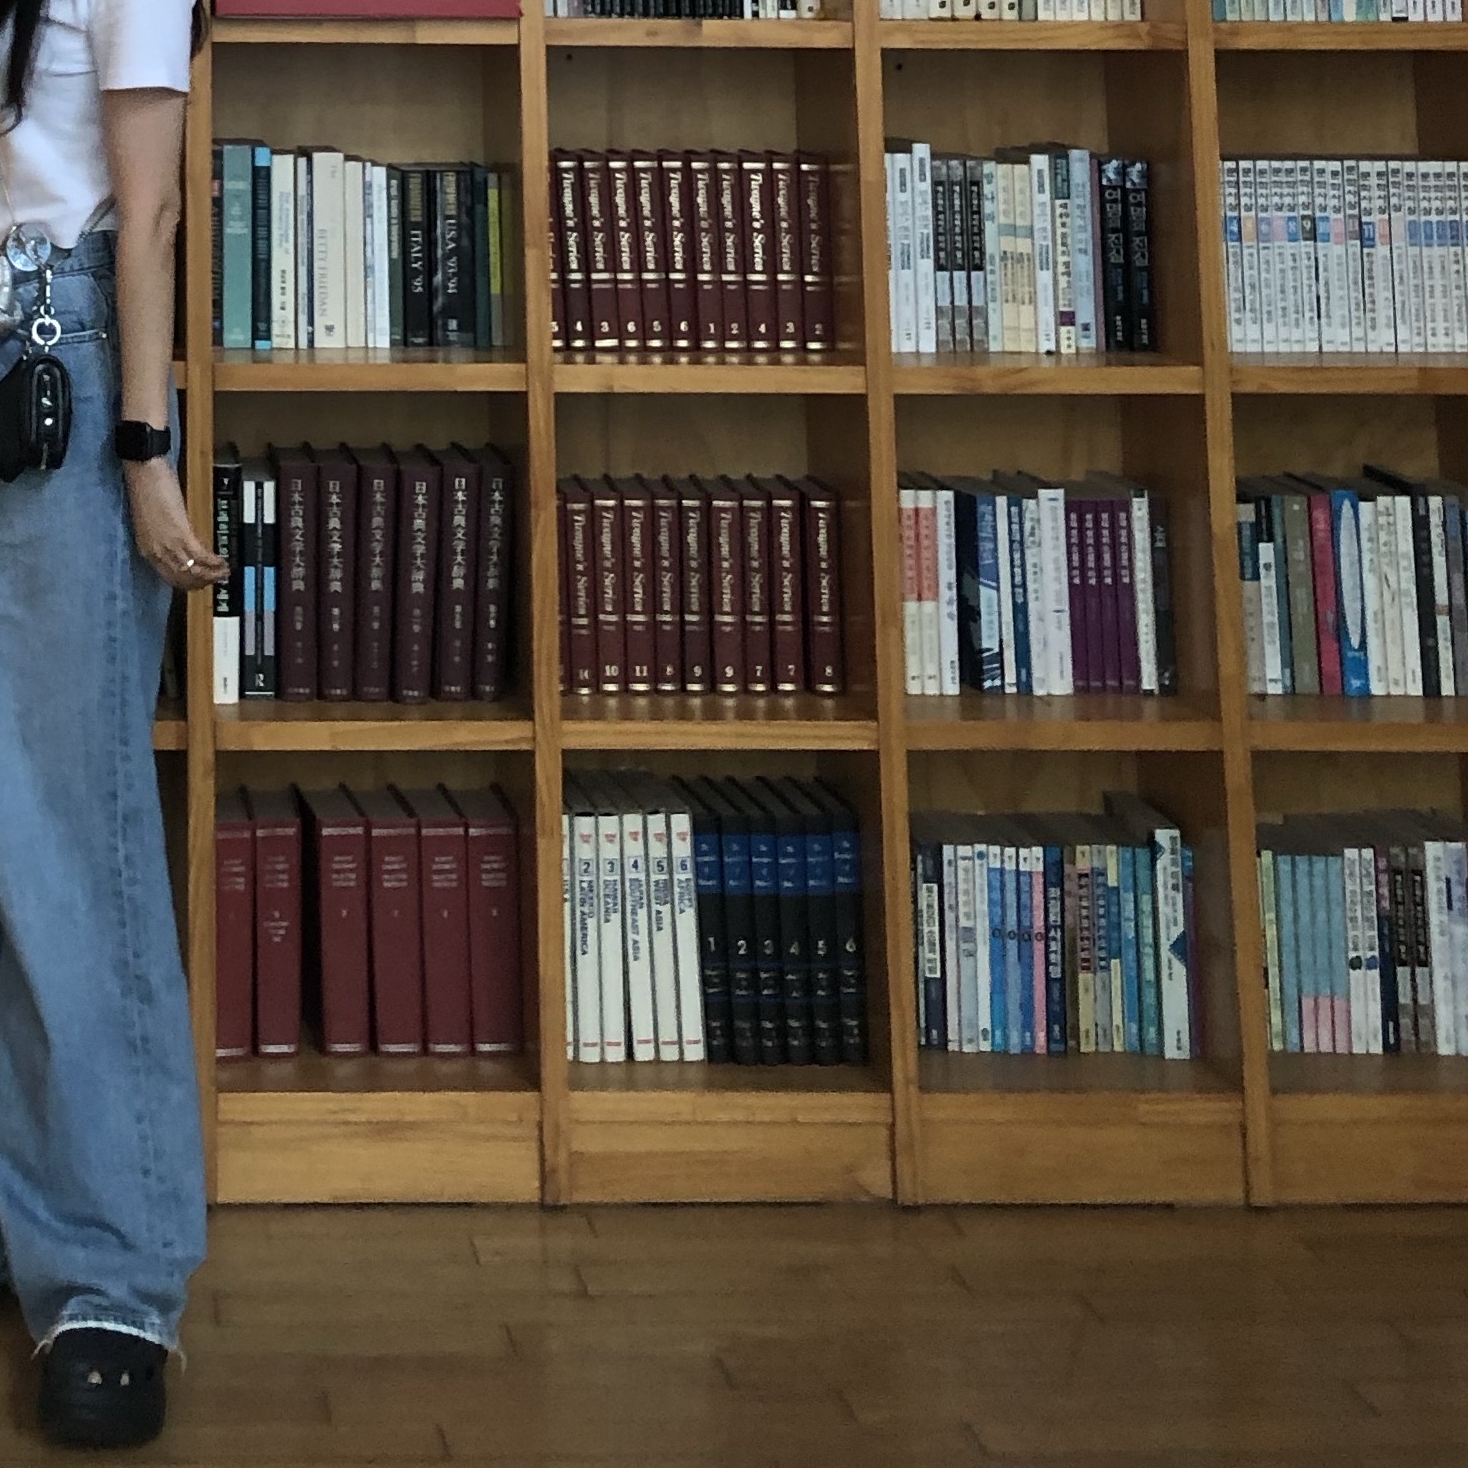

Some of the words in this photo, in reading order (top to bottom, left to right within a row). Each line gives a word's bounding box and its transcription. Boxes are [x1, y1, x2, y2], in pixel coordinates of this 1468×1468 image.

[614, 173, 629, 227] Twayne's
[317, 229, 328, 264] BETTY
[411, 230, 422, 268] ITALY
[620, 232, 633, 269] Series
[317, 267, 328, 317] FRIEDAN
[412, 275, 423, 293] '95
[631, 511, 643, 567] Twayne's
[632, 572, 645, 611] Series
[583, 862, 590, 873] 2
[607, 861, 614, 872] 3
[632, 860, 638, 870] 4
[656, 861, 664, 872] 5
[680, 860, 687, 870] 6
[603, 880, 611, 923] OCEANIA
[629, 878, 638, 937] SOUTHEAST
[653, 880, 662, 906] WEST
[677, 878, 685, 914] AFRICA
[579, 910, 589, 956] AMERICA
[655, 910, 663, 932] ASIA
[632, 940, 640, 961] ASIA
